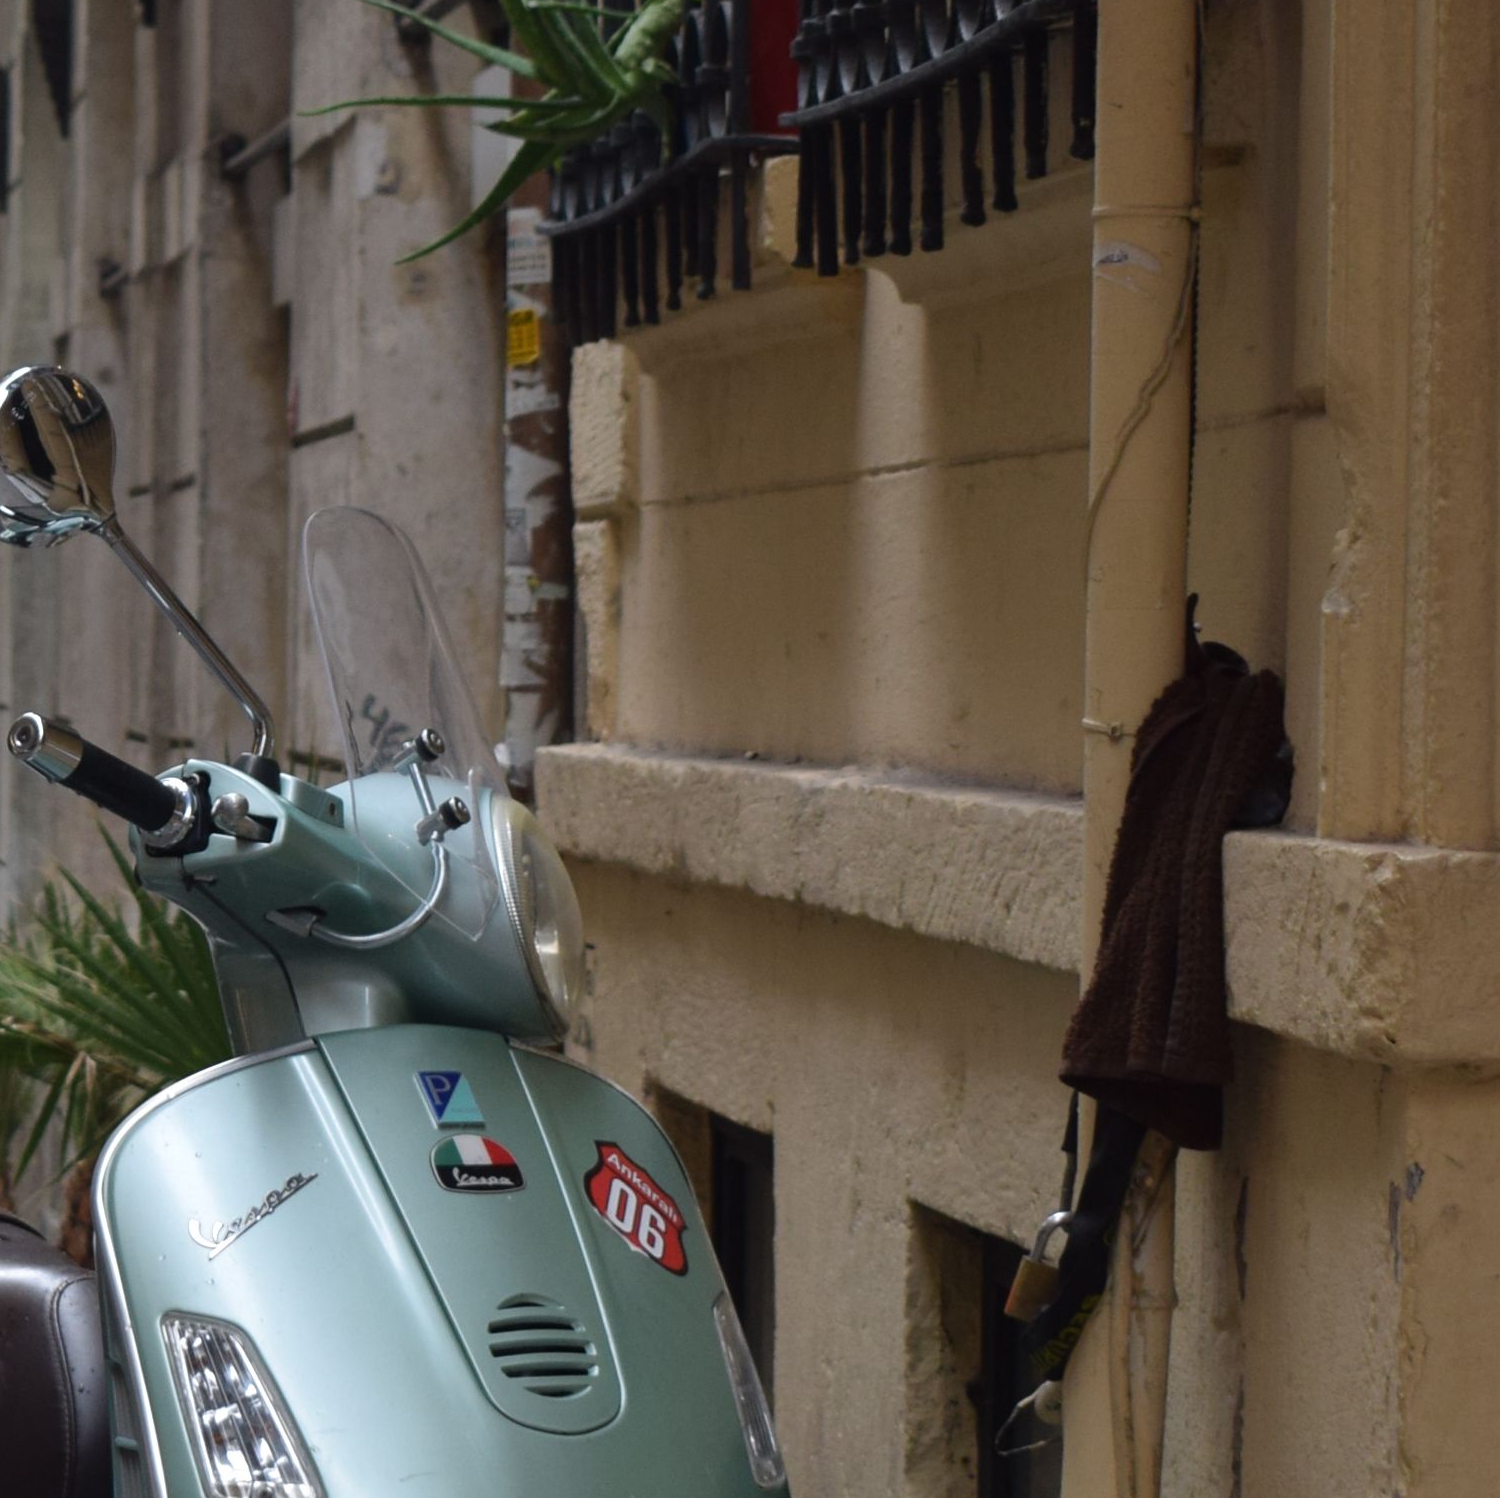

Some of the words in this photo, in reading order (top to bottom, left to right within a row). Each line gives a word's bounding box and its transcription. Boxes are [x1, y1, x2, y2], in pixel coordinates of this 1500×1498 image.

[425, 1074, 452, 1105] P
[452, 1166, 516, 1187] Vespa
[188, 1172, 318, 1261] Vespa
[606, 1177, 666, 1259] 06
